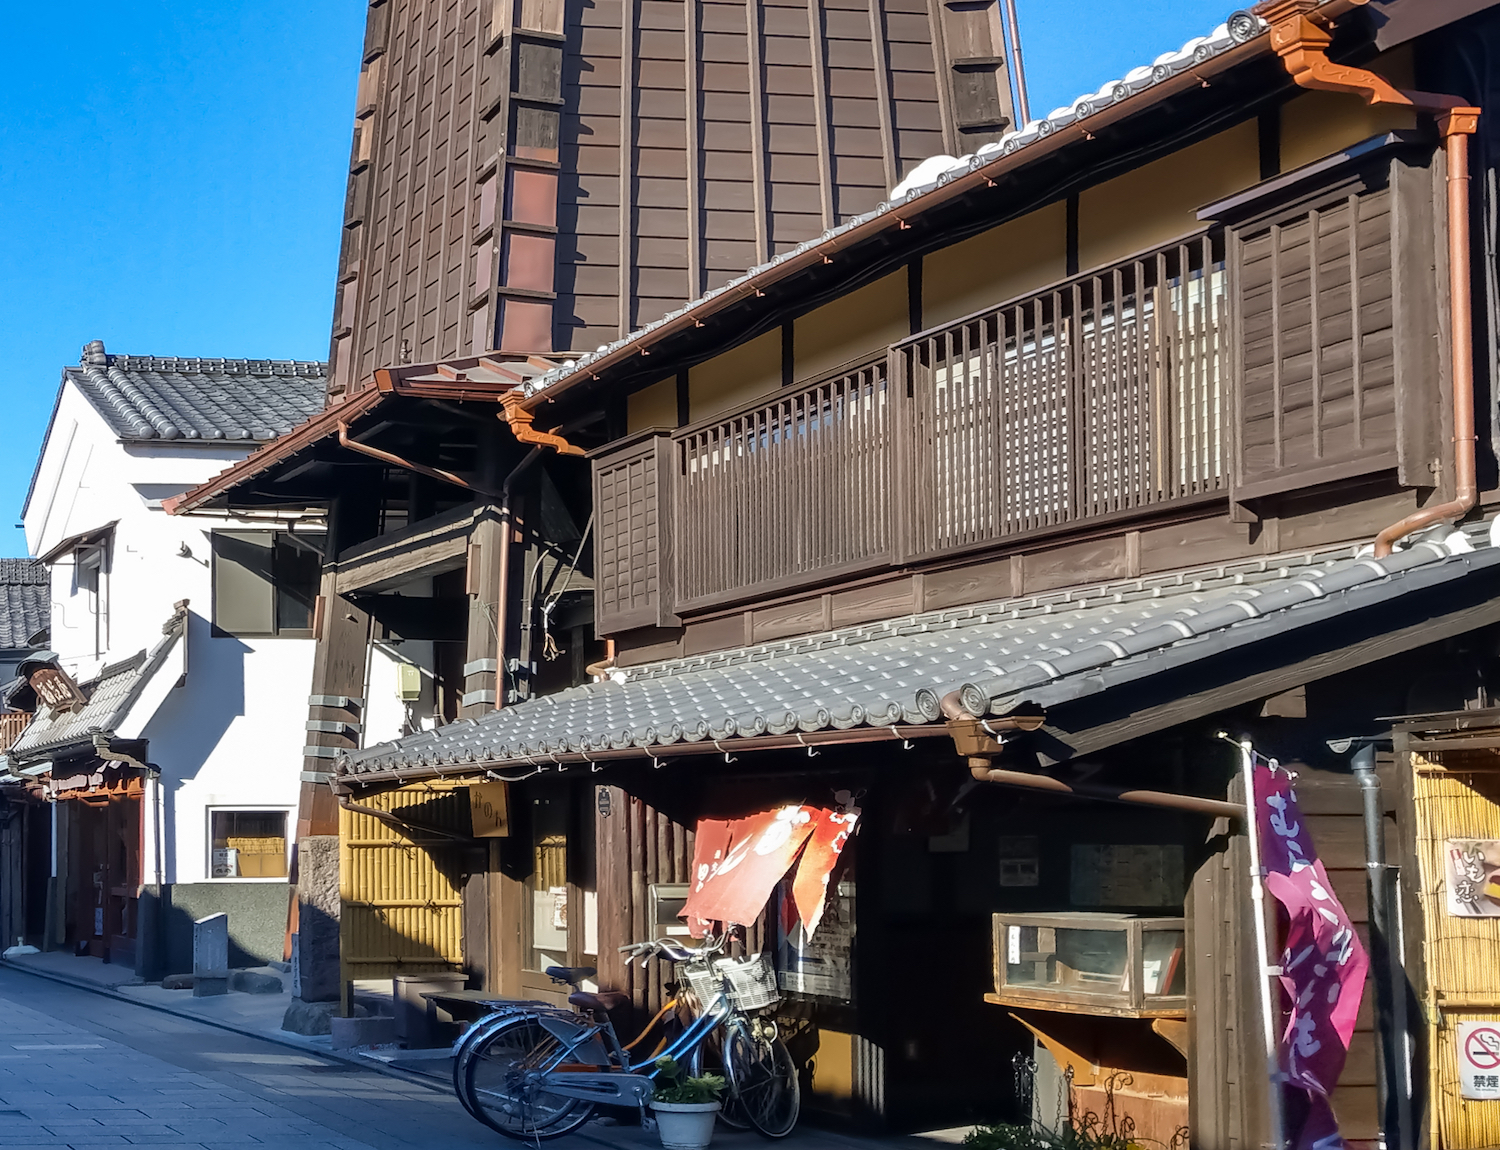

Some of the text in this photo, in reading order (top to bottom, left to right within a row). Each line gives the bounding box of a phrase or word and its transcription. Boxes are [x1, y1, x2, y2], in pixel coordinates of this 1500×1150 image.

[1455, 851, 1485, 904] いも恋
[1473, 1075, 1499, 1087] 禁煙
